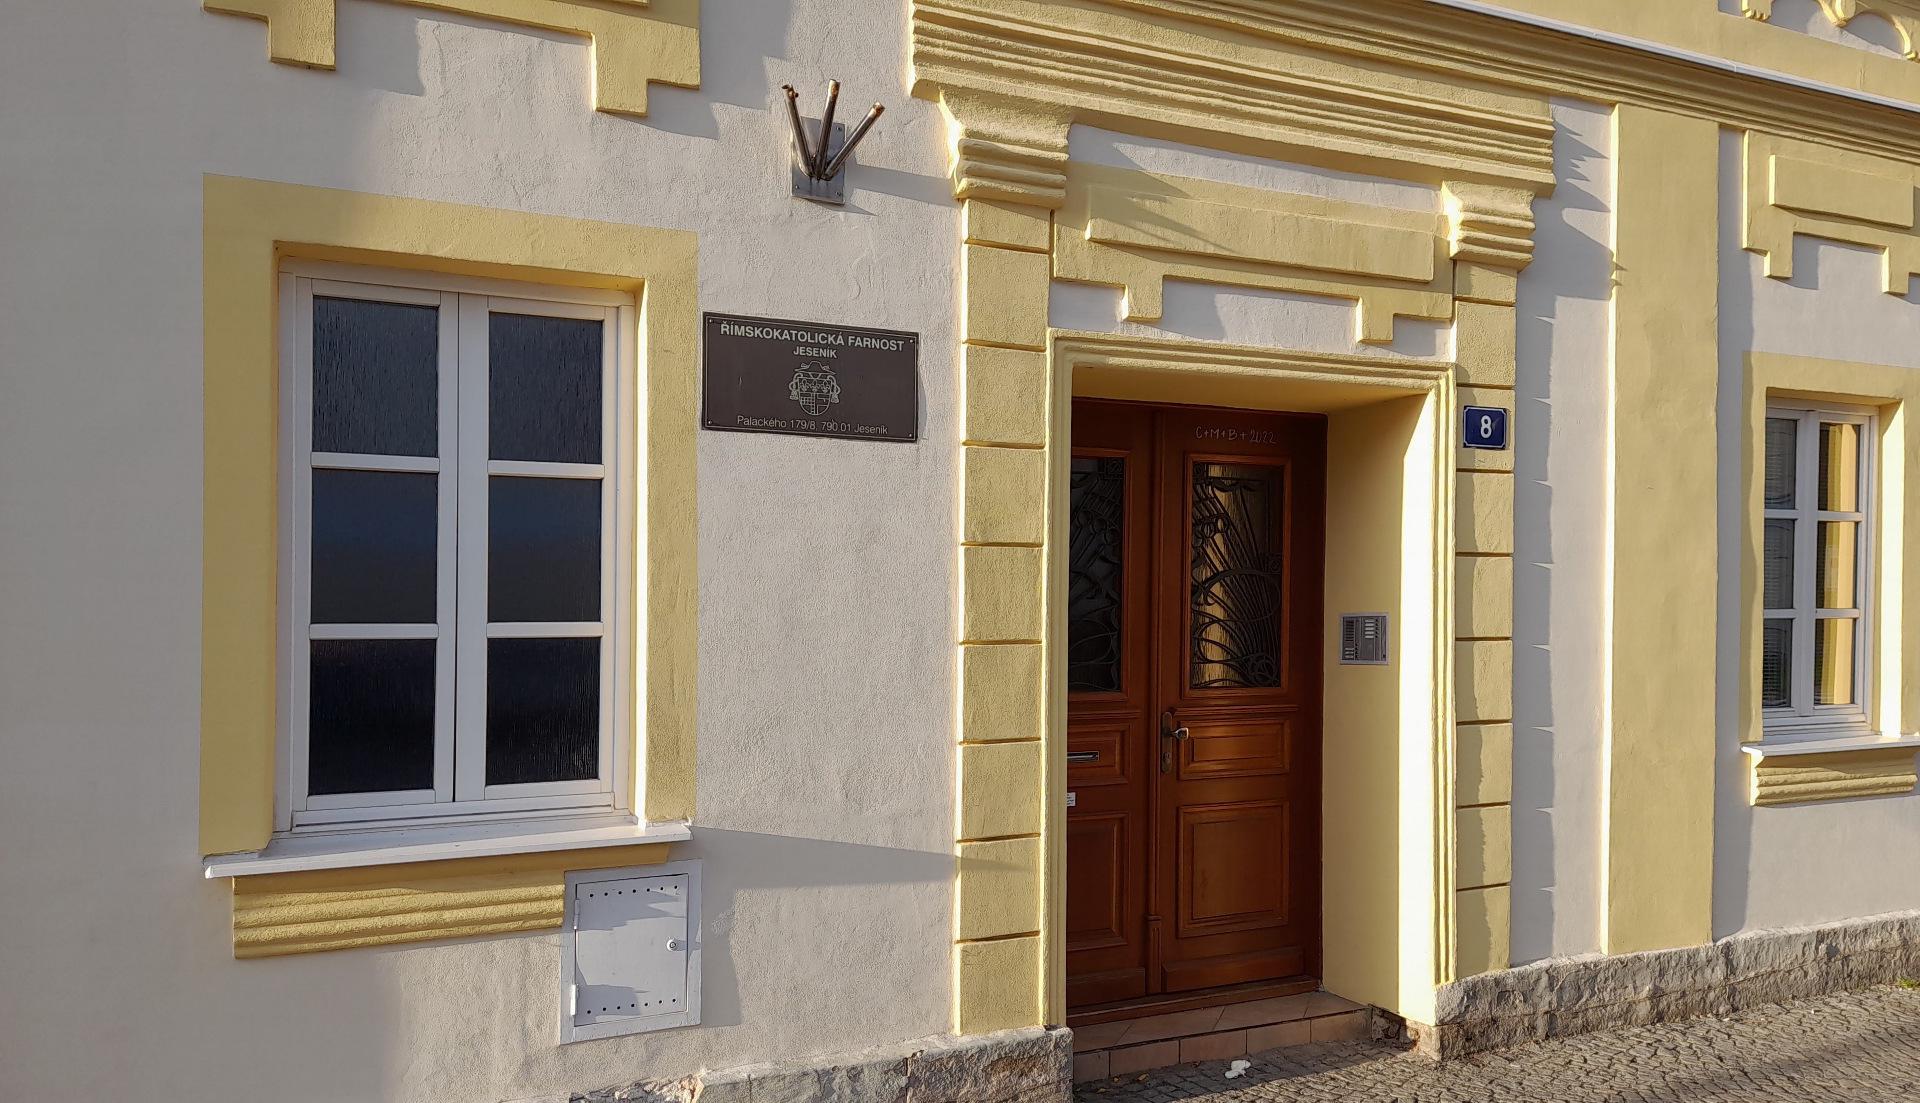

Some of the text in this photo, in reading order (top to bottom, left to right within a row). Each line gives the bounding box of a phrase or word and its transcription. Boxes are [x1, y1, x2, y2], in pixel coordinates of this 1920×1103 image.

[720, 321, 905, 352] ŘÍMSKOKATOLICKÁ FARNOST
[793, 345, 838, 359] JESENÍK
[737, 415, 787, 429] Palackého
[821, 420, 838, 432] 790
[840, 422, 851, 432] 01
[854, 423, 888, 435] Jeseník
[1480, 415, 1492, 439] 8
